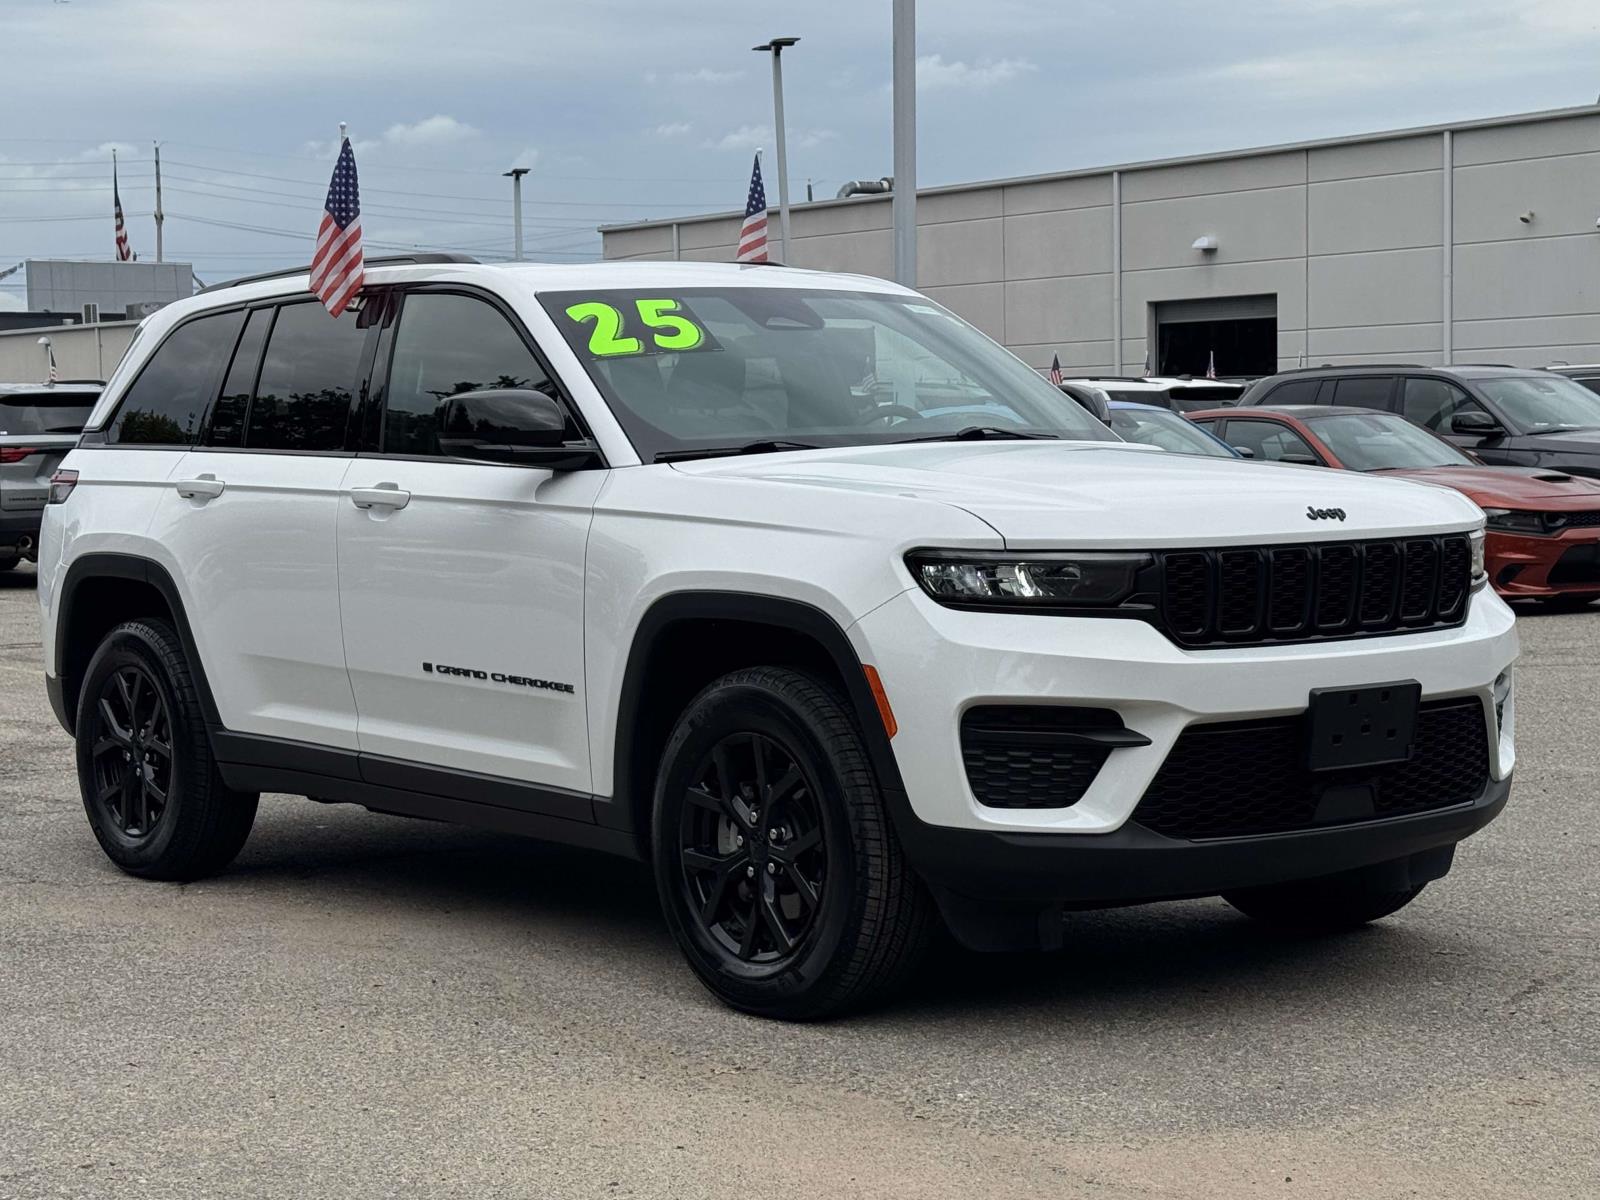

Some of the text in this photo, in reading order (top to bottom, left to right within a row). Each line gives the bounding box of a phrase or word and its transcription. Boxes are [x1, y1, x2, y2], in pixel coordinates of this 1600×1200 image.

[565, 299, 704, 356] 25
[1306, 506, 1346, 522] Jeep
[436, 664, 575, 695] GRAND CHEROKEE
